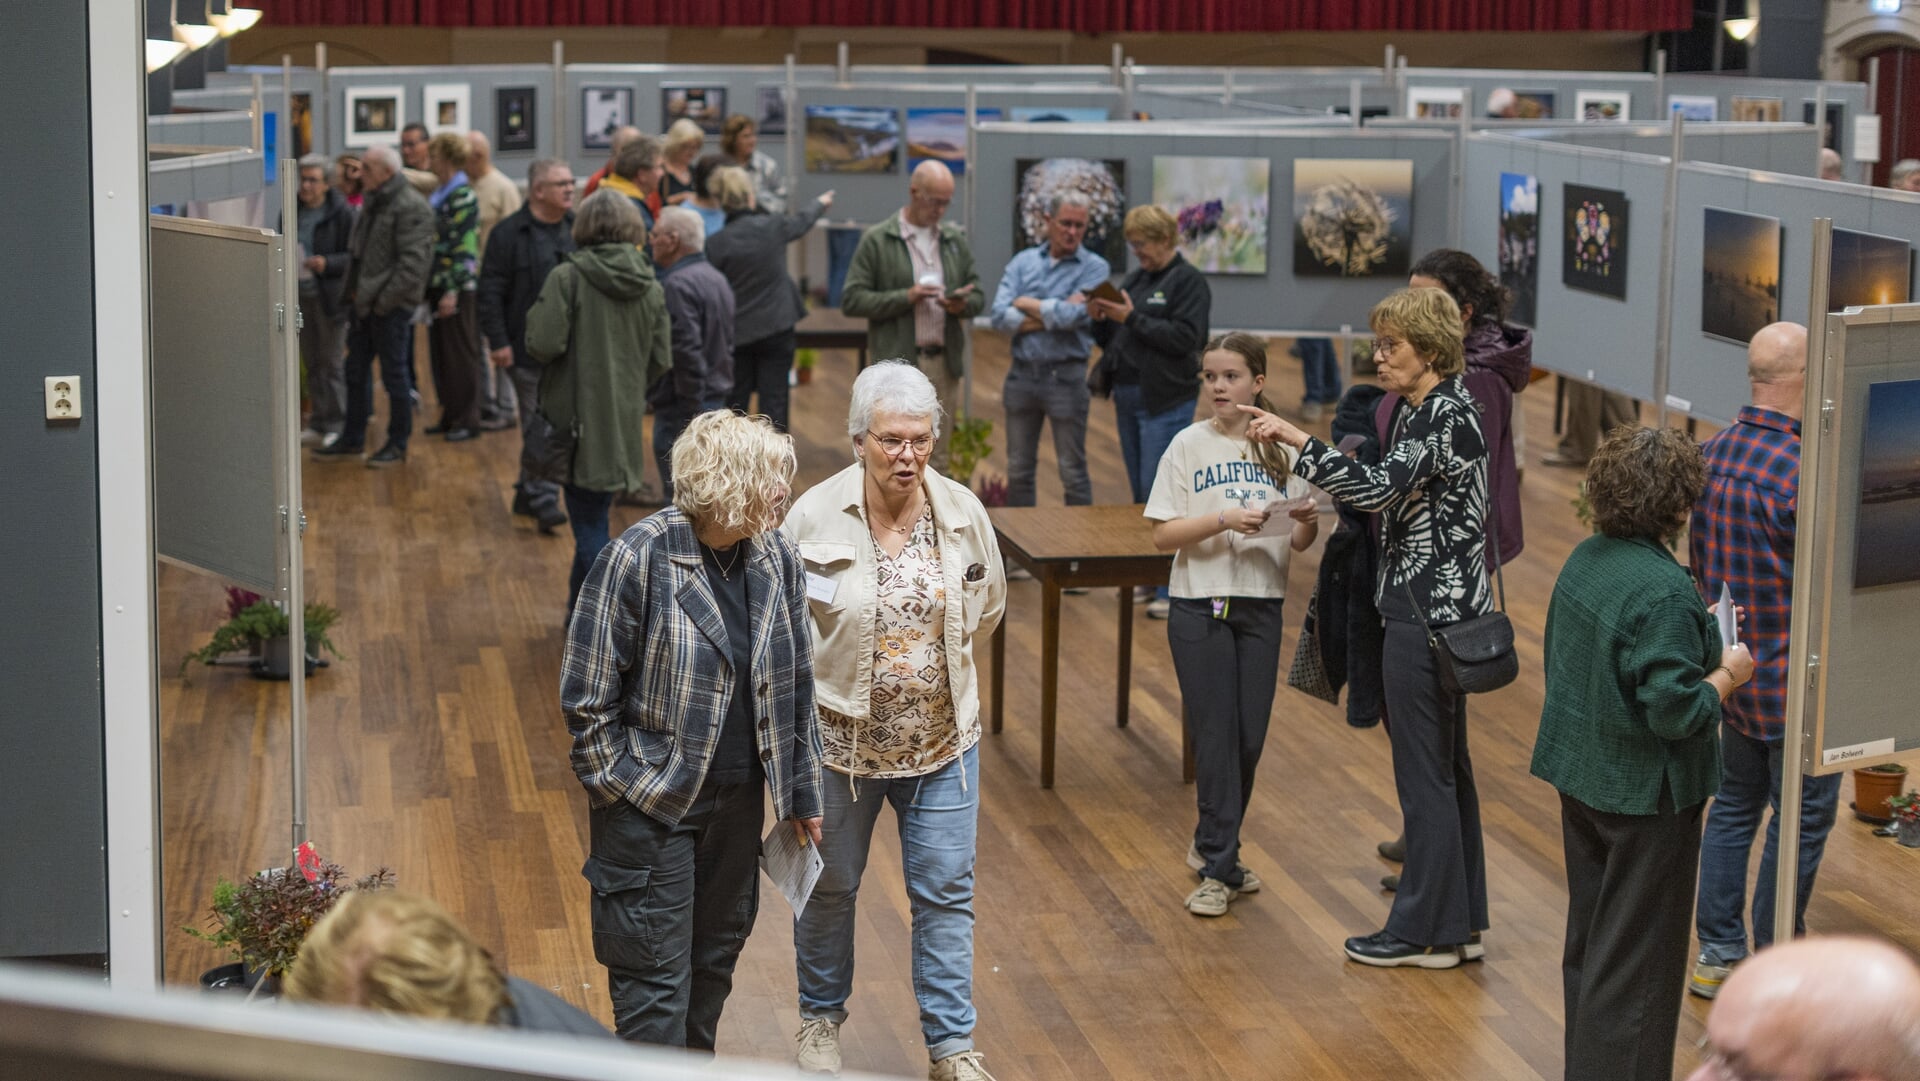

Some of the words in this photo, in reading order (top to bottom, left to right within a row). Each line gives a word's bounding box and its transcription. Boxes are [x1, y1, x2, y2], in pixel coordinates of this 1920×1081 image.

[1194, 462, 1288, 499] CALIFORNA
[1225, 488, 1251, 499] CRW
[1829, 752, 1840, 762] Jan
